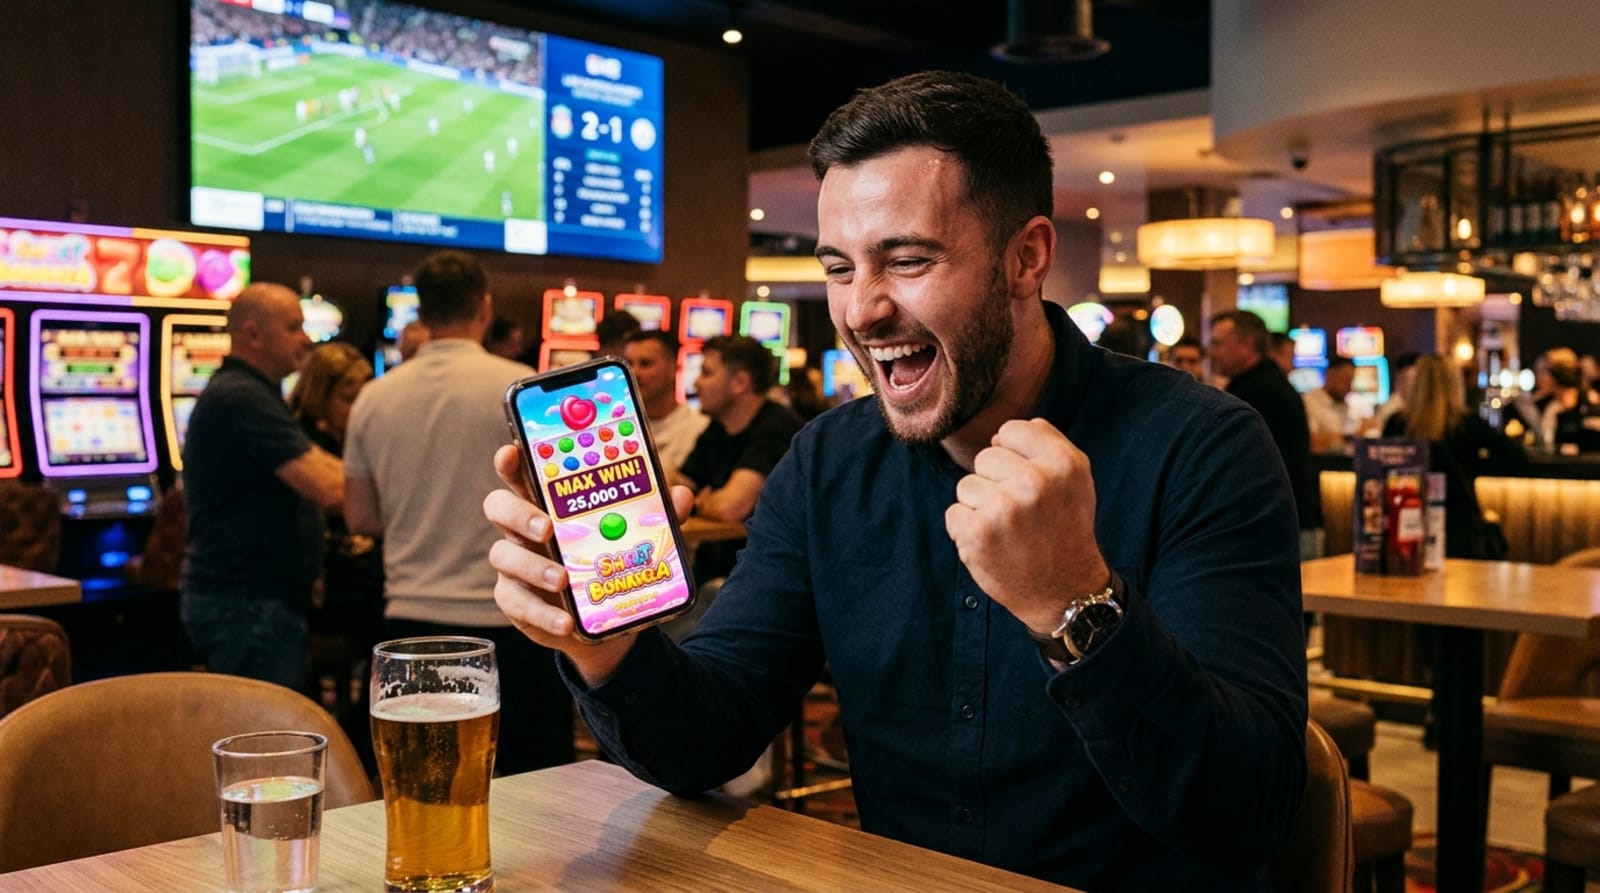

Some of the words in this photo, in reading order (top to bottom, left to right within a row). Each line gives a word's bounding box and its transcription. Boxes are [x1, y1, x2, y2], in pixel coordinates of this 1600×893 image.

[581, 111, 623, 144] 2-1
[554, 472, 597, 497] MAX
[597, 459, 642, 484] WIN!
[566, 487, 619, 513] 25,000
[619, 481, 641, 496] TL
